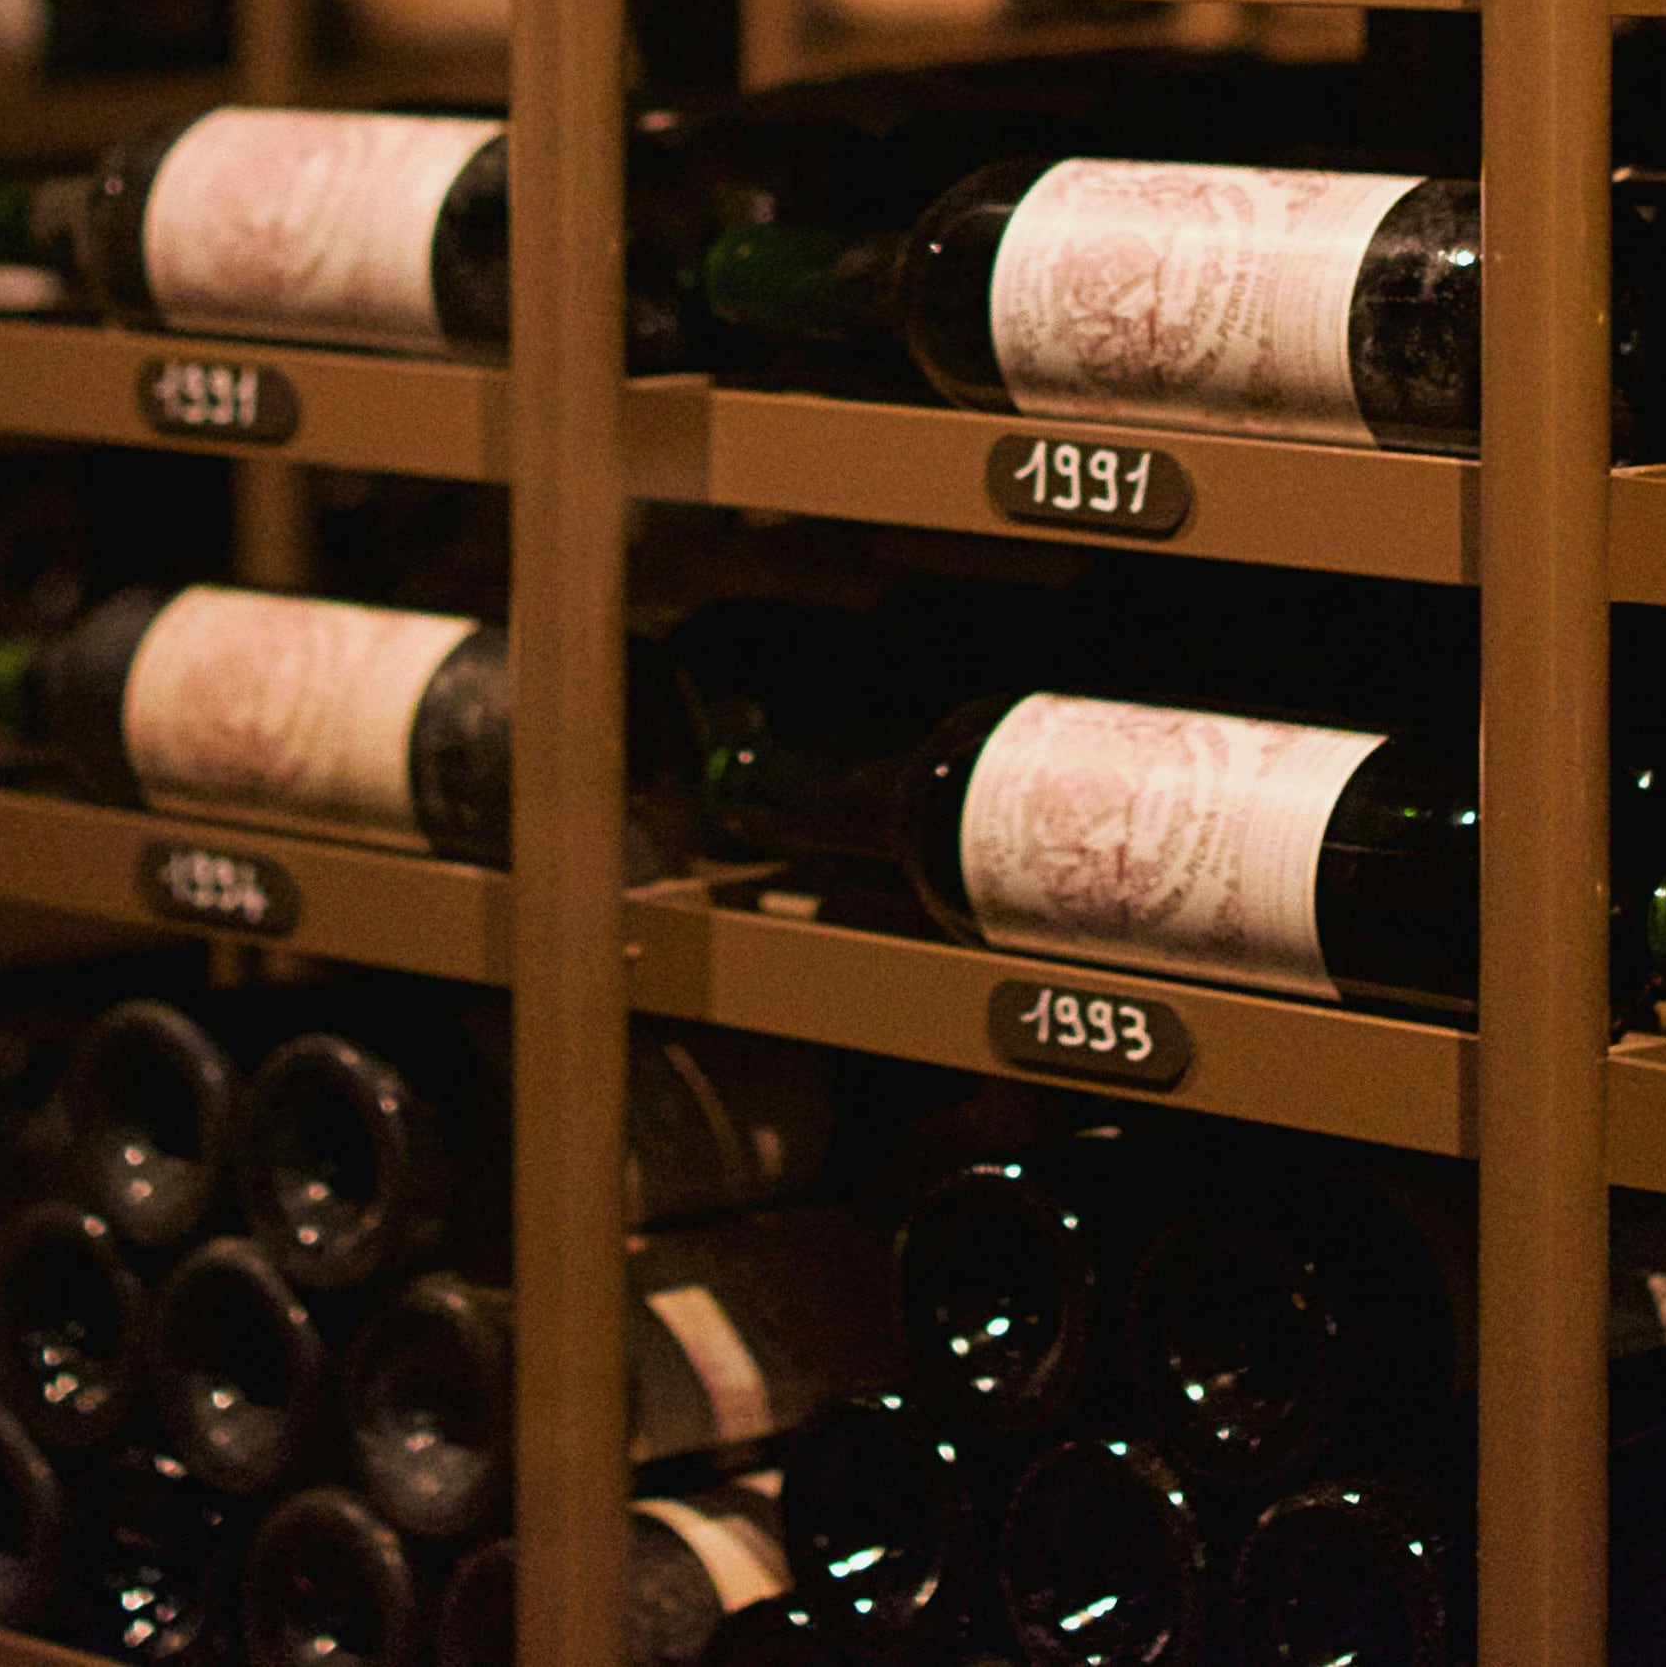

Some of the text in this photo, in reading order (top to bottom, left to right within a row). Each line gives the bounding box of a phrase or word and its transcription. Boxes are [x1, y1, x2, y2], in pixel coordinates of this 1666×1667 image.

[155, 363, 257, 428] 1991
[1014, 440, 1151, 514] 1991
[1021, 988, 1153, 1062] 1993
